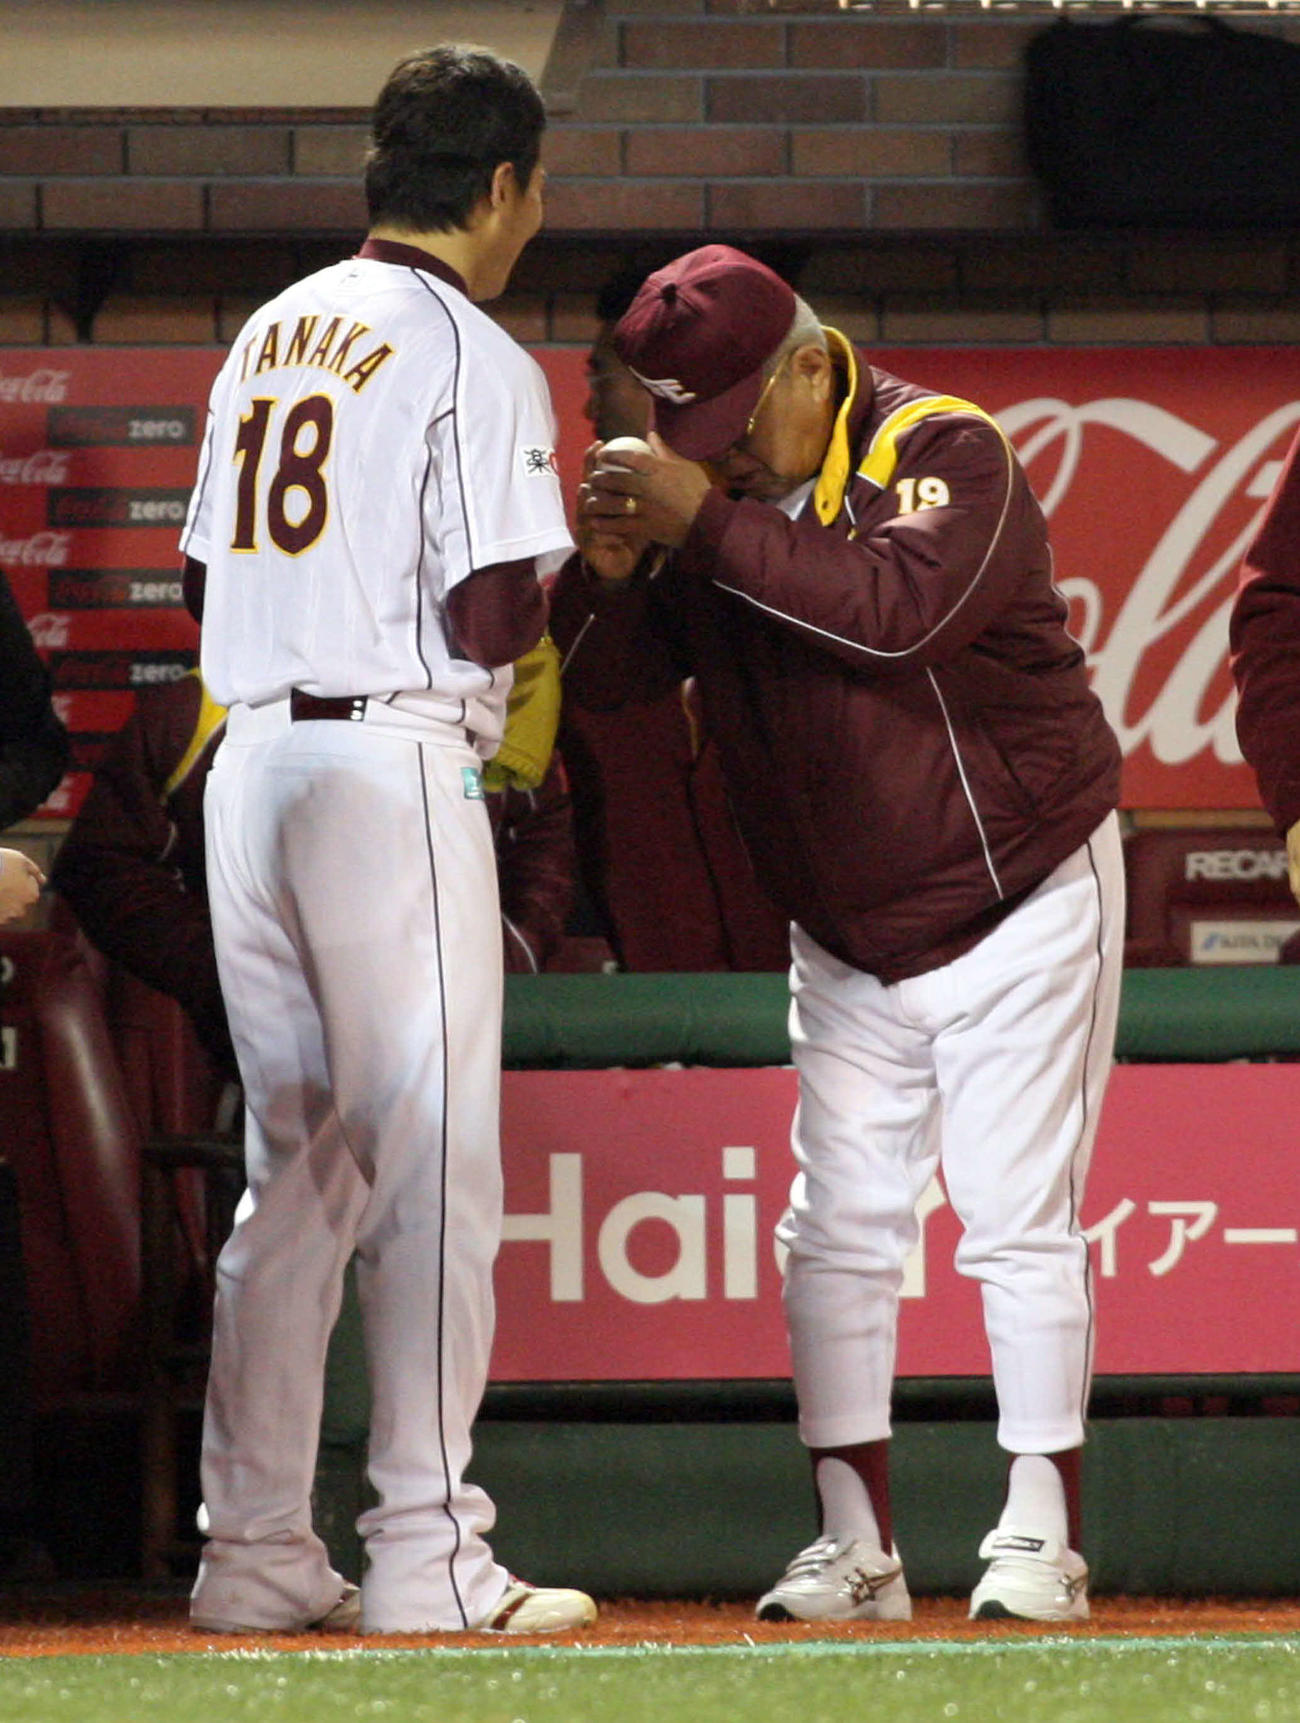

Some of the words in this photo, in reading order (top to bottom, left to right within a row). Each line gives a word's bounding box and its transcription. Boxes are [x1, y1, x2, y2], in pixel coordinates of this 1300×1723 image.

[239, 315, 395, 393] TANAKA
[128, 419, 186, 439] zero
[230, 393, 334, 558] 18
[129, 500, 187, 520] zero
[895, 476, 951, 515] 19
[130, 582, 183, 601] zero
[130, 663, 187, 683] zero
[500, 1146, 946, 1303] Hair
